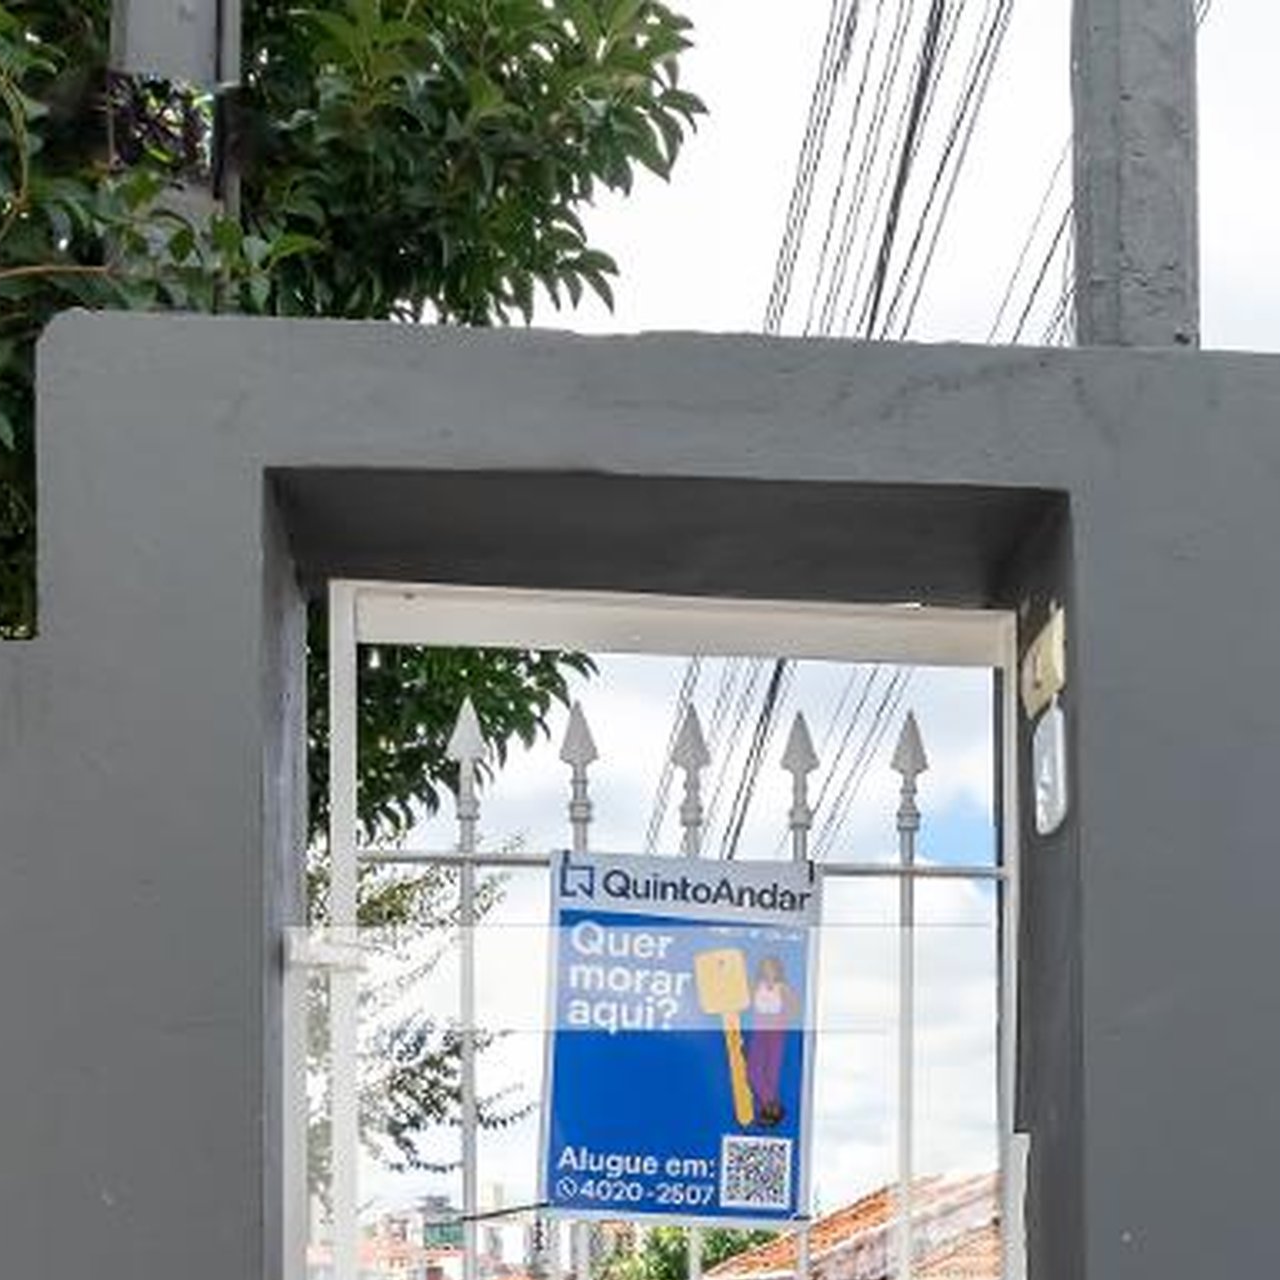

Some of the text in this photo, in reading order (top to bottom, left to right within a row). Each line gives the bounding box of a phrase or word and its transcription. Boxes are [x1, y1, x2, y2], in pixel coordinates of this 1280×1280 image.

[602, 868, 812, 912] QuintoAndar
[571, 920, 674, 958] Quer
[570, 965, 692, 996] morar
[567, 995, 679, 1035] aqui?
[557, 1146, 715, 1179] Alugue em:
